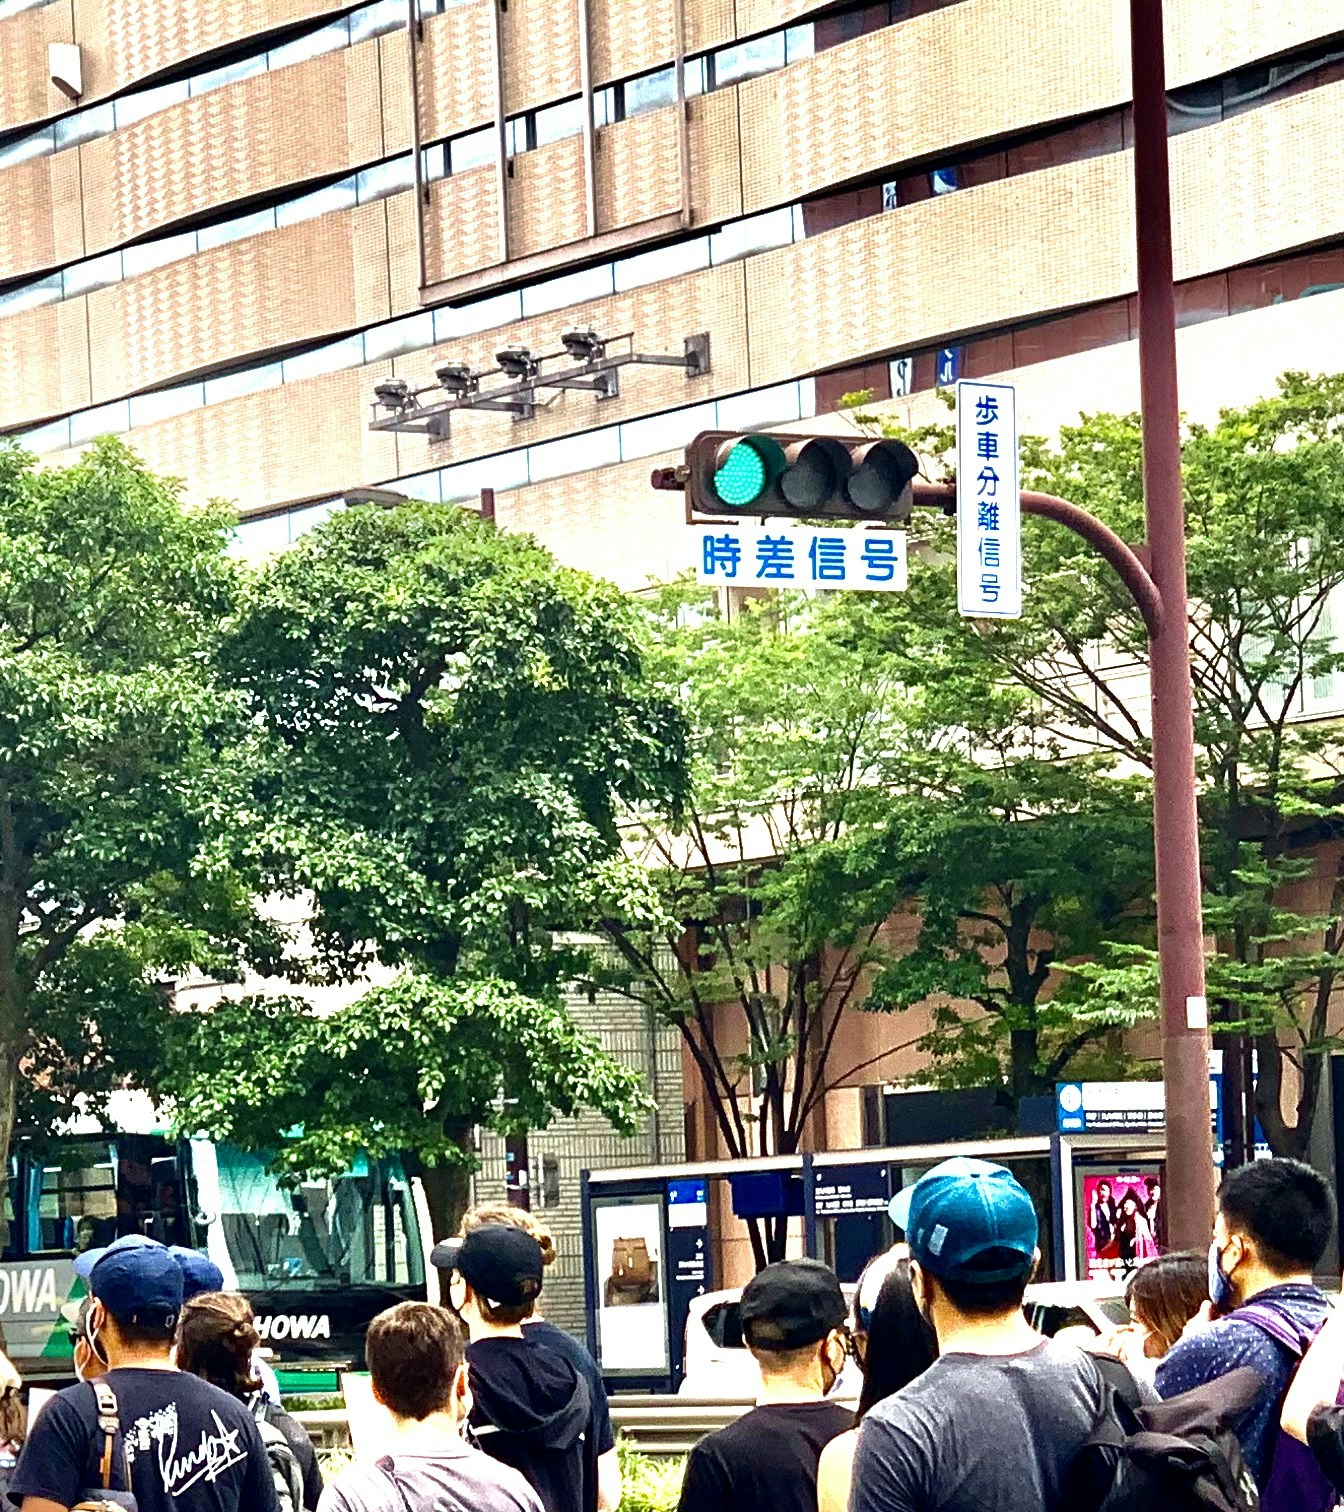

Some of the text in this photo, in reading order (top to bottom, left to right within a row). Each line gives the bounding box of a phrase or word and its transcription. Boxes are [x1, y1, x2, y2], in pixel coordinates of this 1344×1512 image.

[702, 533, 899, 582] 時差信号
[974, 394, 1002, 604] 歩車分離信号
